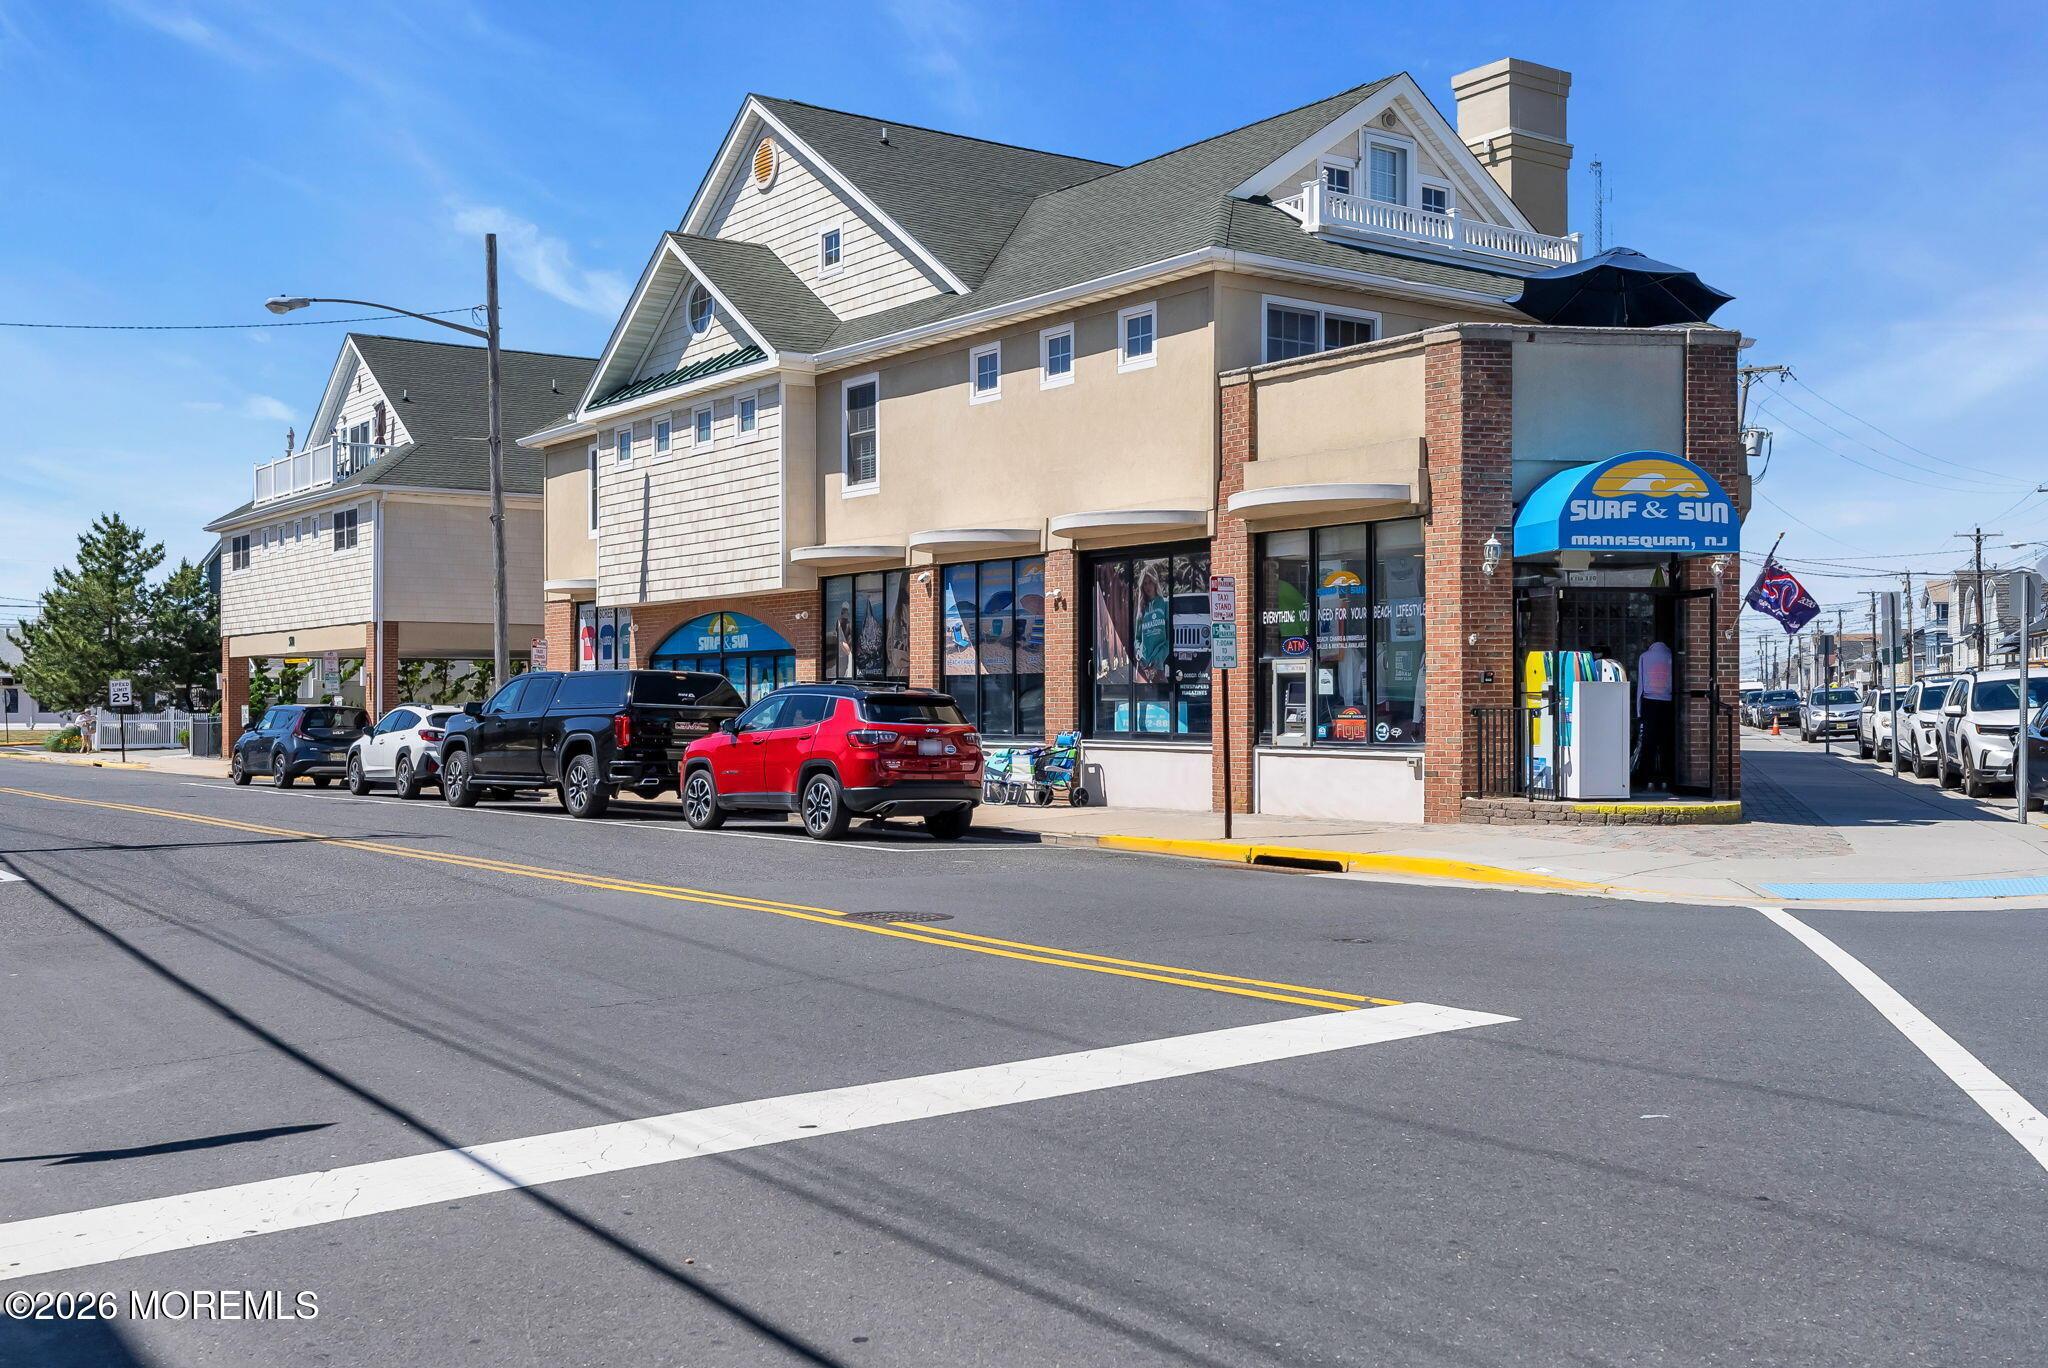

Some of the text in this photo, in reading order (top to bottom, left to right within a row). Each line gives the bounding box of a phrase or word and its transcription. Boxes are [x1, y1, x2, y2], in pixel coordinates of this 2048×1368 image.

[1570, 499, 1729, 524] SURF & SUN
[1571, 535, 1728, 550] MANASQUAN, NJ
[1216, 593, 1229, 601] TAXI
[1214, 602, 1232, 611] STAND
[1263, 603, 1426, 624] EVERYTHING YOU NEED FOR YOUR BEACH LIFESTYLE
[698, 633, 749, 651] SURF & SUN
[1287, 640, 1306, 652] ATM
[112, 692, 130, 703] 25
